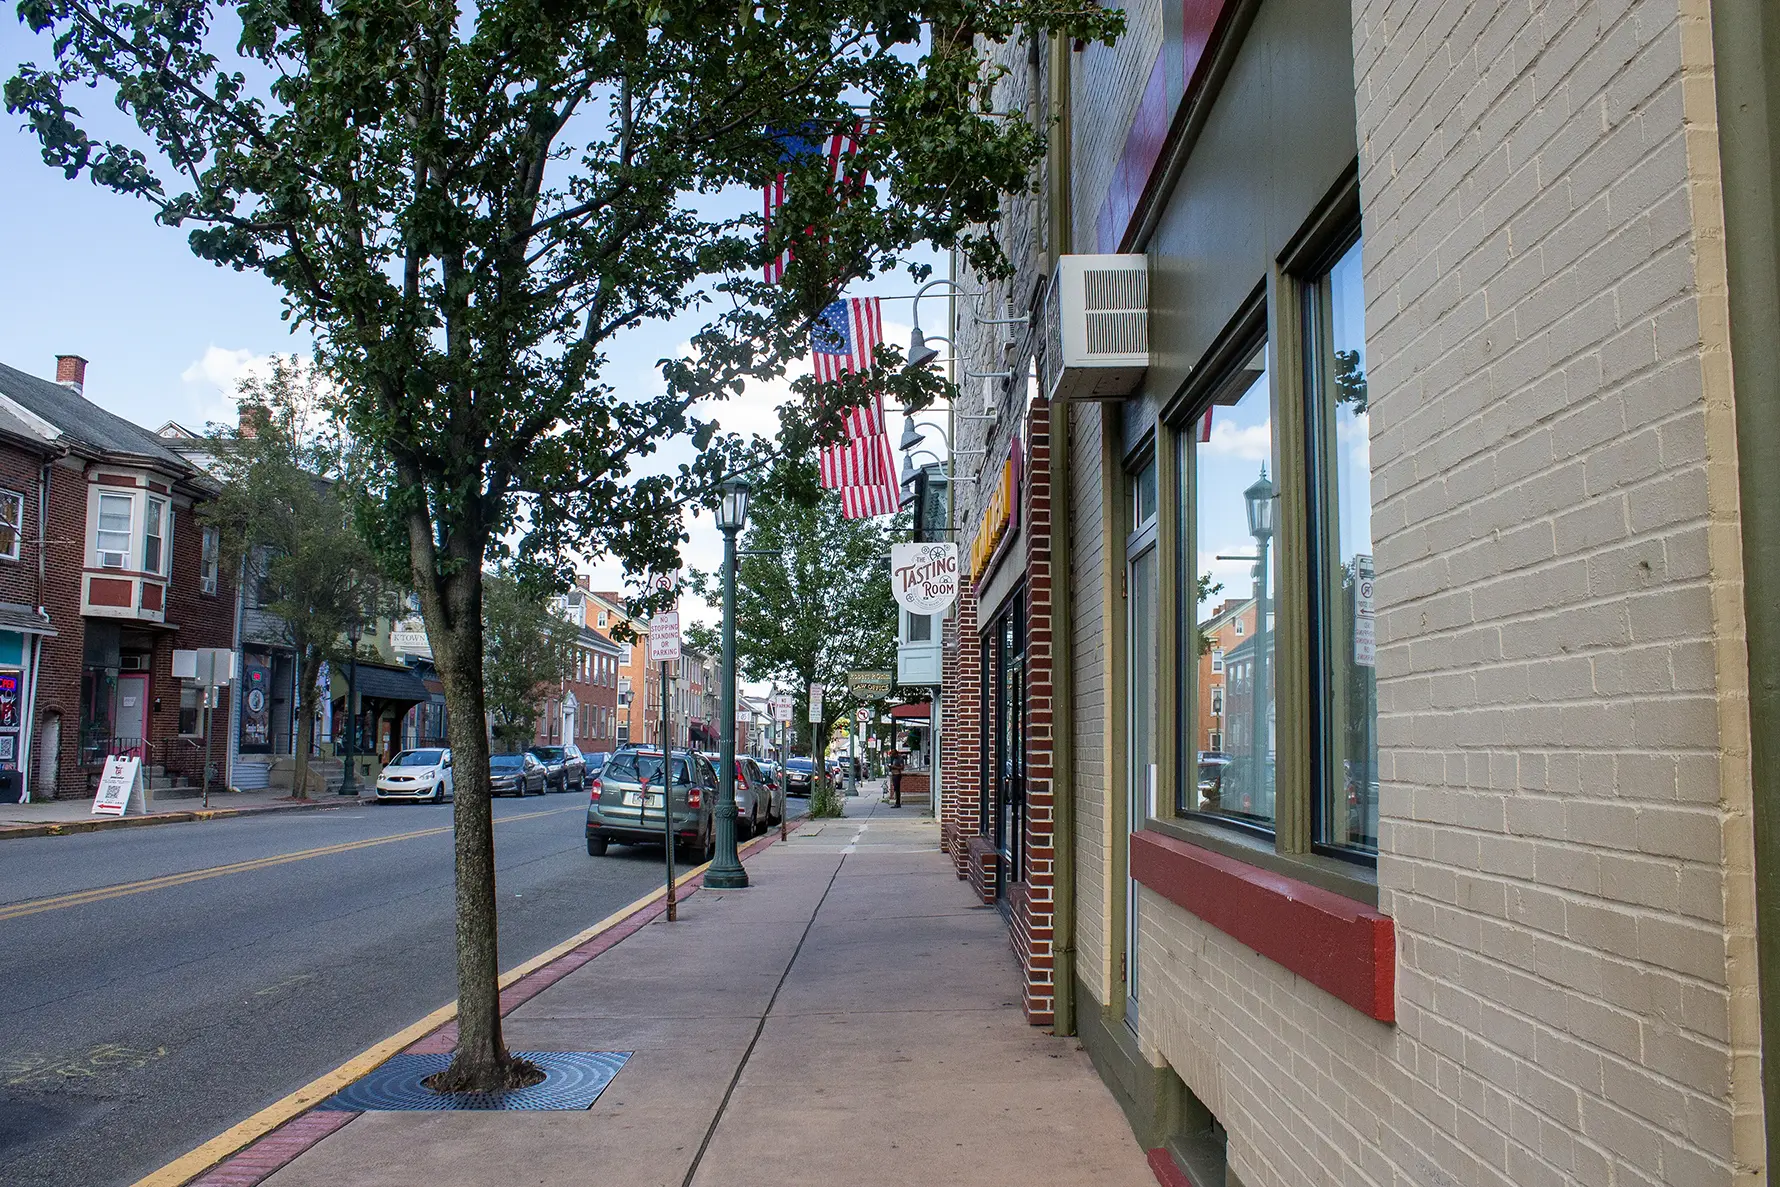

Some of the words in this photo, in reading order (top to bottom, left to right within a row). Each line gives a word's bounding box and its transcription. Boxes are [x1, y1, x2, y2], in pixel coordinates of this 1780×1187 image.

[894, 556, 956, 593] TASTING
[921, 581, 954, 598] ROOM
[651, 623, 678, 632] STOPPING
[651, 631, 678, 640] STANDING
[653, 648, 677, 656] PARKING
